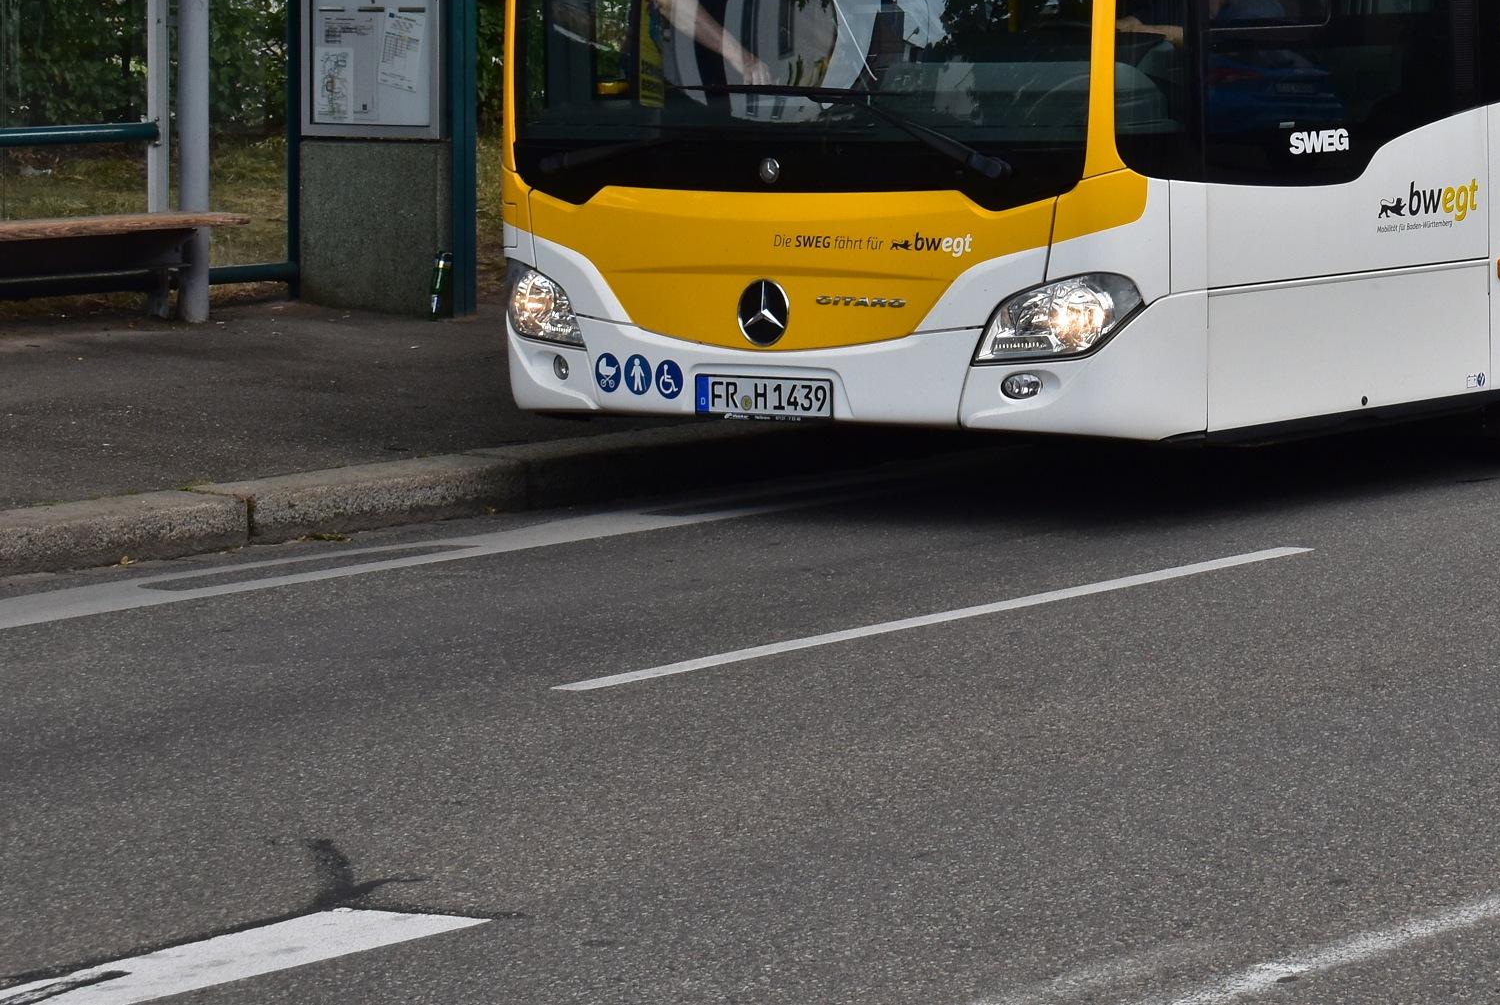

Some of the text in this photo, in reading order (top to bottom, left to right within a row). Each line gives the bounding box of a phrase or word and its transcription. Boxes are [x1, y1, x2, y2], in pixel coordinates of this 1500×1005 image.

[1289, 128, 1350, 155] SWEG
[1408, 178, 1478, 222] bwegt
[1377, 220, 1453, 234] Mobilität für Baden-Württemberg
[773, 232, 973, 258] Die SWEG fährt für bwegt
[815, 295, 906, 309] CITARO
[711, 381, 739, 408] FR
